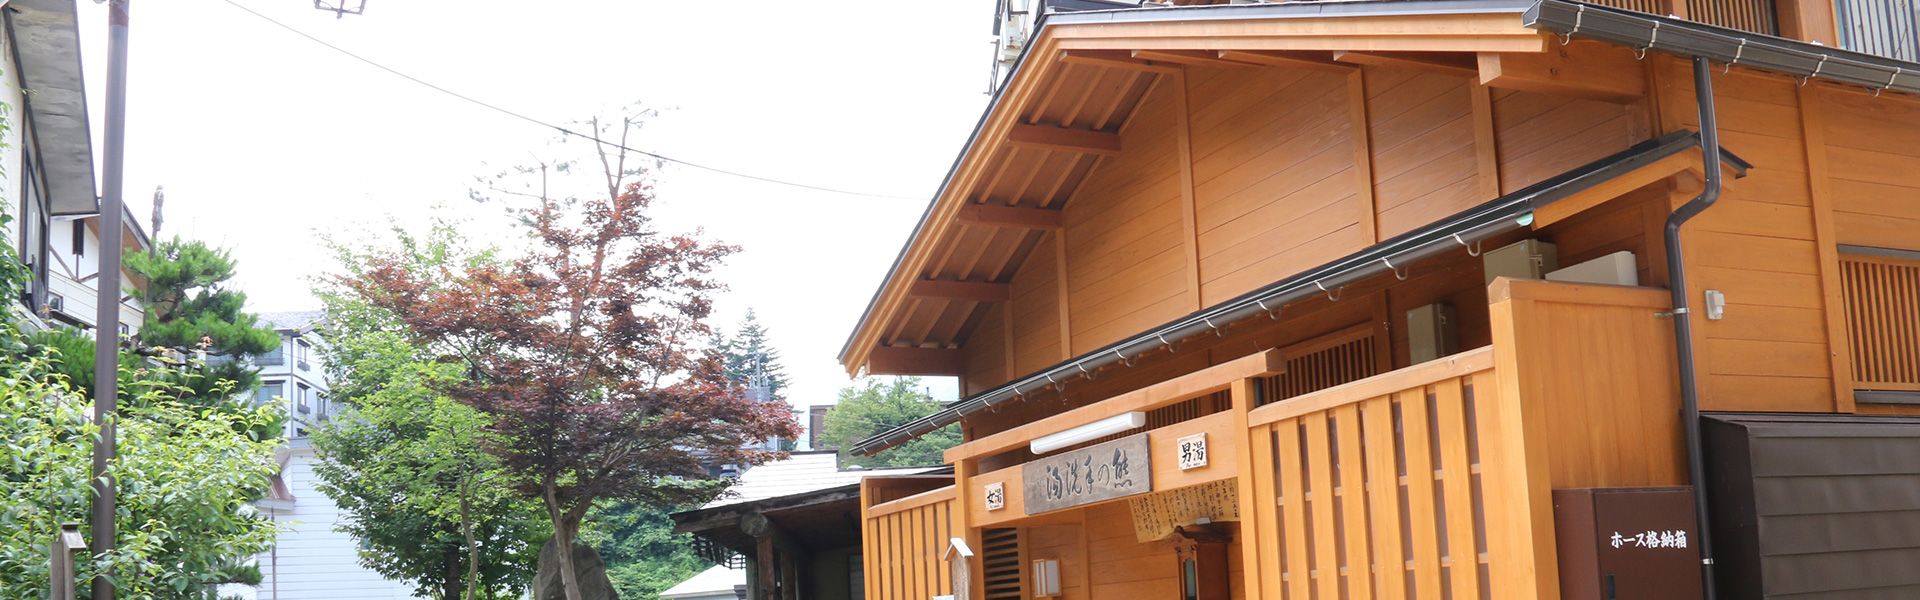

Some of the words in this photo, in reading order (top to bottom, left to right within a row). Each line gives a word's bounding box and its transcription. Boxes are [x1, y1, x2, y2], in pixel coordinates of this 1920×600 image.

[1181, 440, 1204, 463] 男湯
[1611, 530, 1687, 548] ホース格納箱
